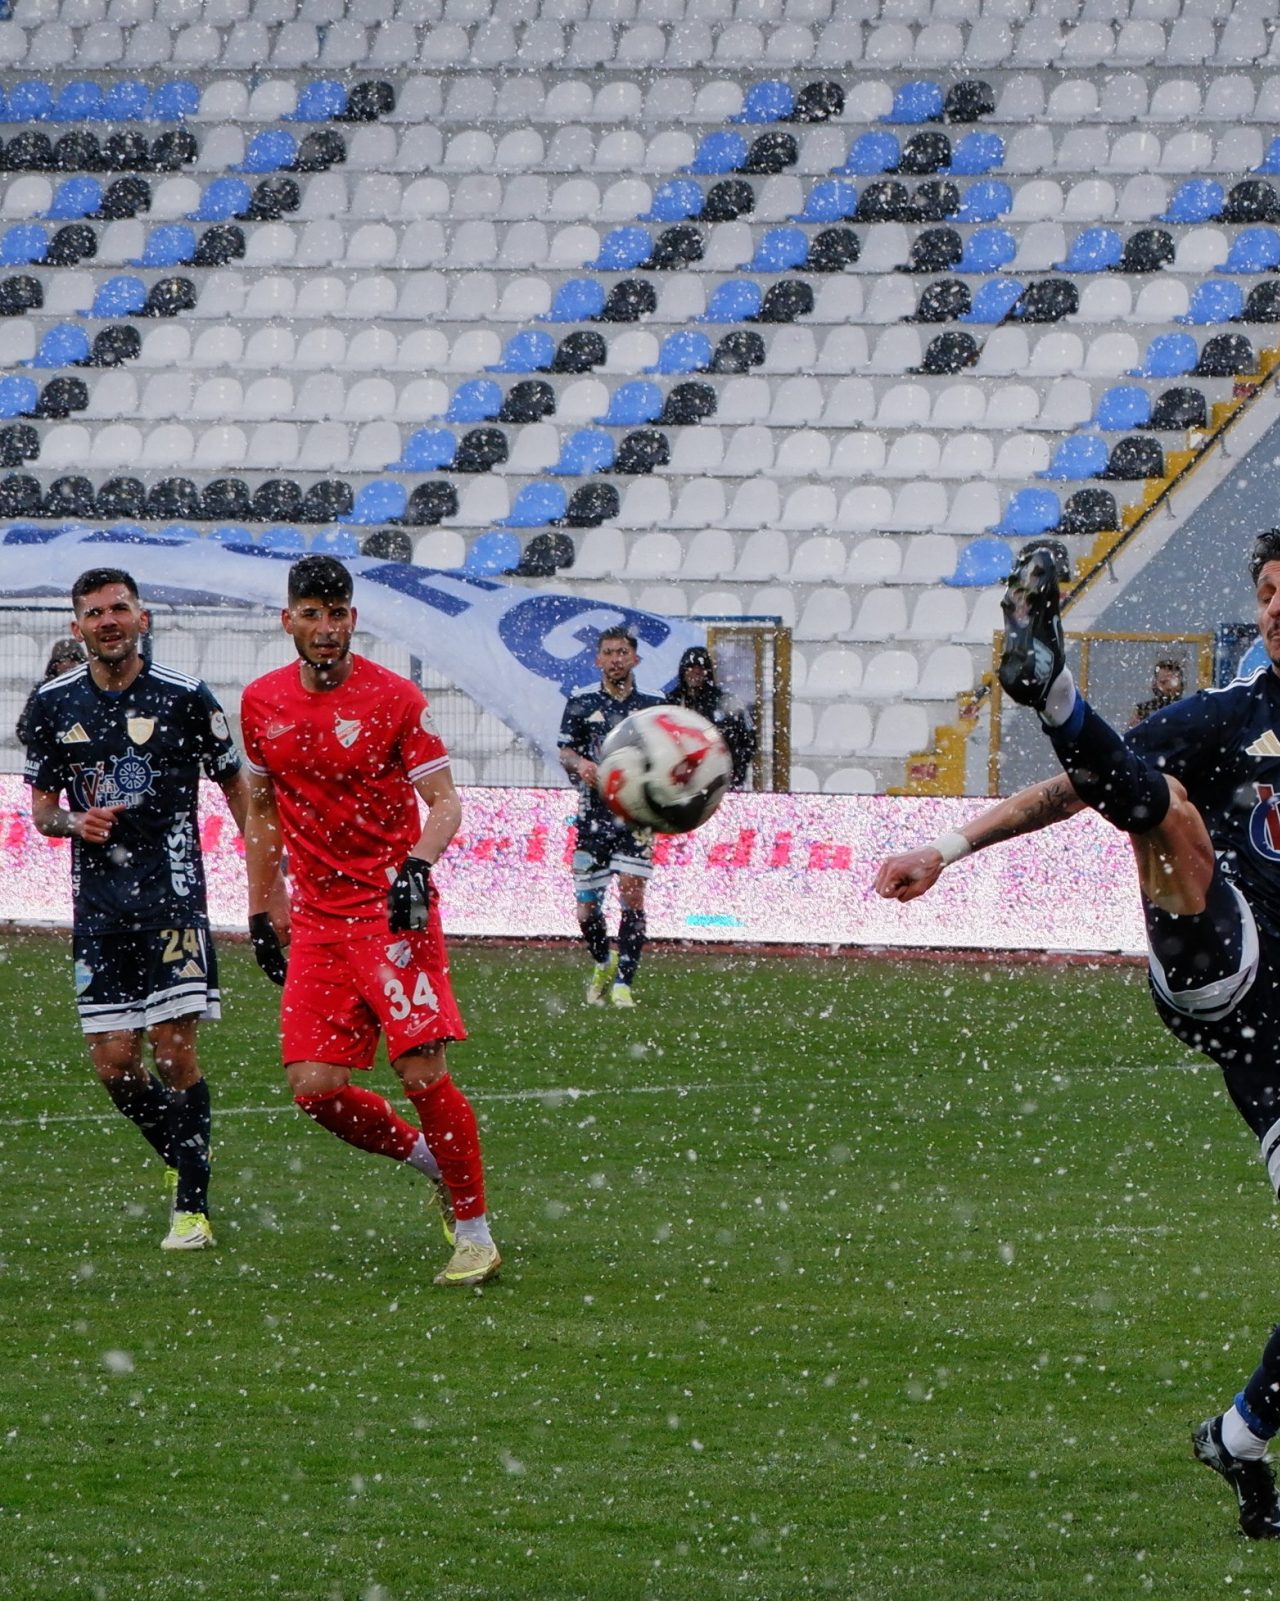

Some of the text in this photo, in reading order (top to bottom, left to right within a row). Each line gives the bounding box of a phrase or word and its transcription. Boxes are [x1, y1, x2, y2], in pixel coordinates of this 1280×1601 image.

[167, 811, 190, 897] AKSU
[160, 929, 199, 964] 24
[384, 971, 439, 1020] 34
